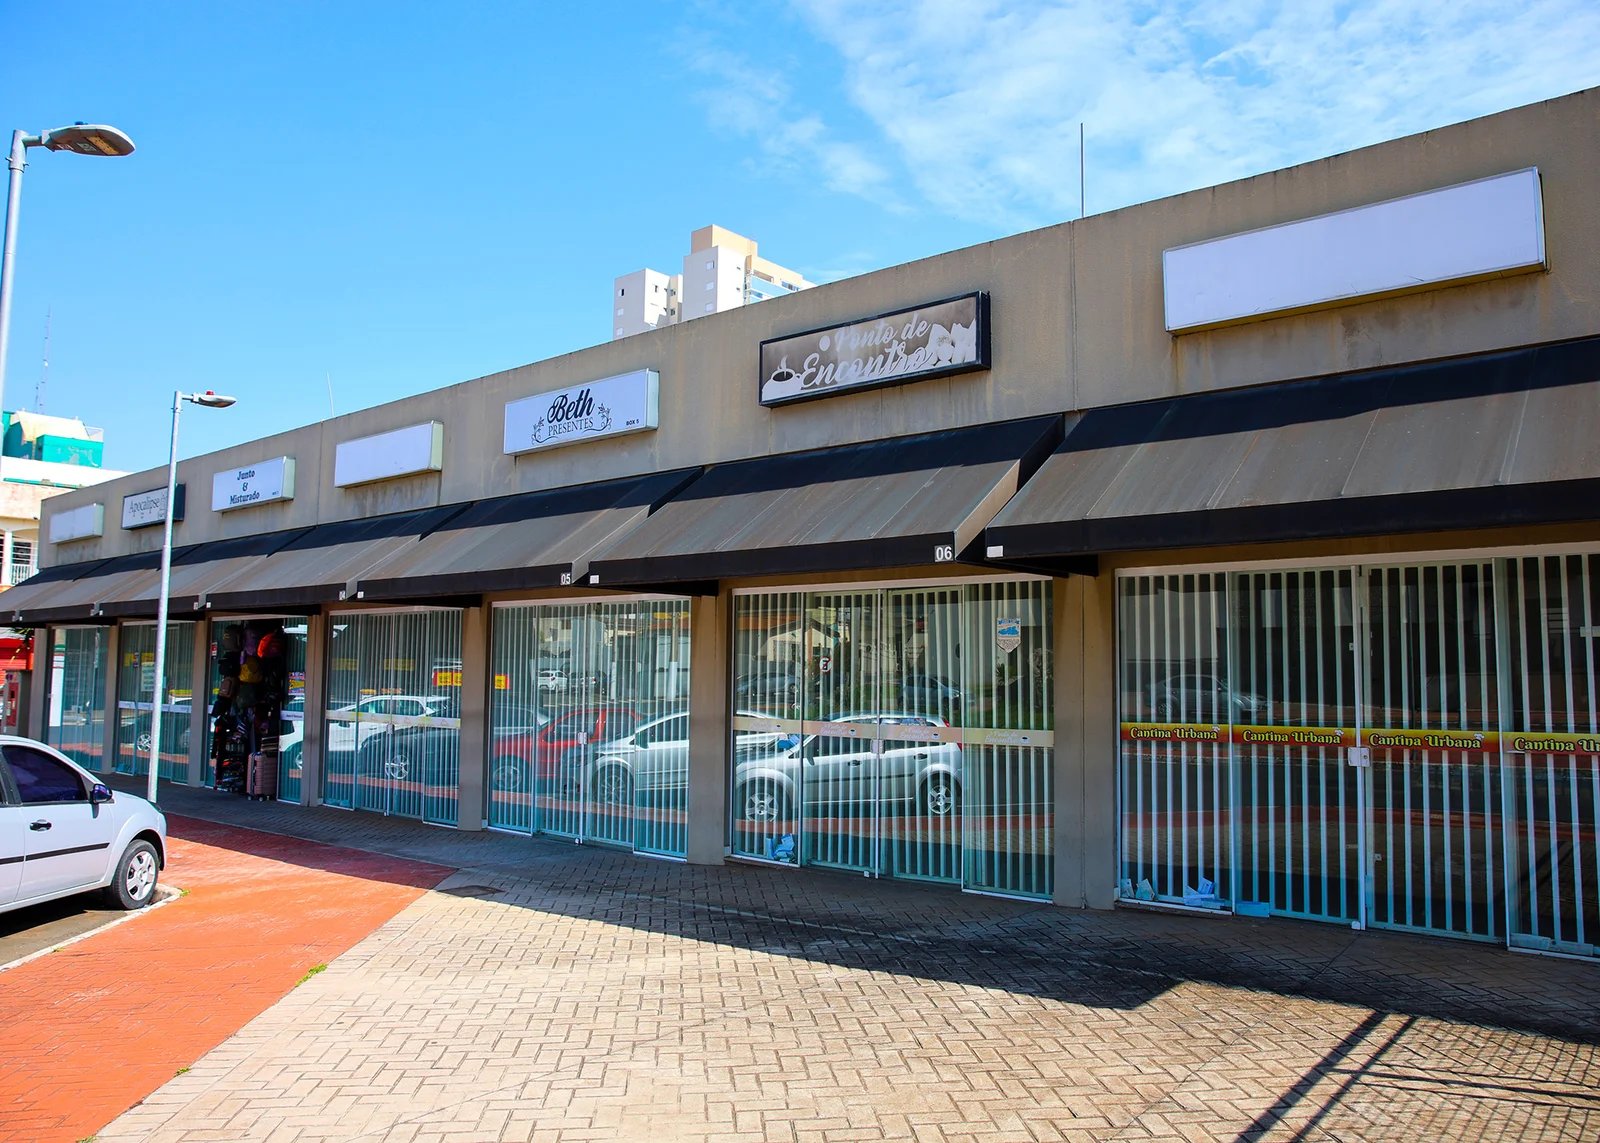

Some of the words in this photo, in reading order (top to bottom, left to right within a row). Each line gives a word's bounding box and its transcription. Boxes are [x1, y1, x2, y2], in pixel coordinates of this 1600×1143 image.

[900, 311, 931, 341] de
[801, 340, 934, 387] Encontro
[547, 388, 595, 424] Beth
[548, 417, 594, 436] PRESENTES
[237, 470, 255, 480] Junto
[242, 482, 248, 491] &
[229, 491, 259, 504] Misturado
[936, 546, 953, 561] 06
[561, 573, 571, 585] 05
[1130, 726, 1171, 740] Cantina
[1174, 727, 1218, 740] Urbana
[1243, 730, 1289, 743] Cantina
[1292, 731, 1341, 745] Urbana
[1369, 733, 1421, 747] Cantina
[1425, 735, 1481, 749] Urbana
[1514, 737, 1575, 752] Cantina
